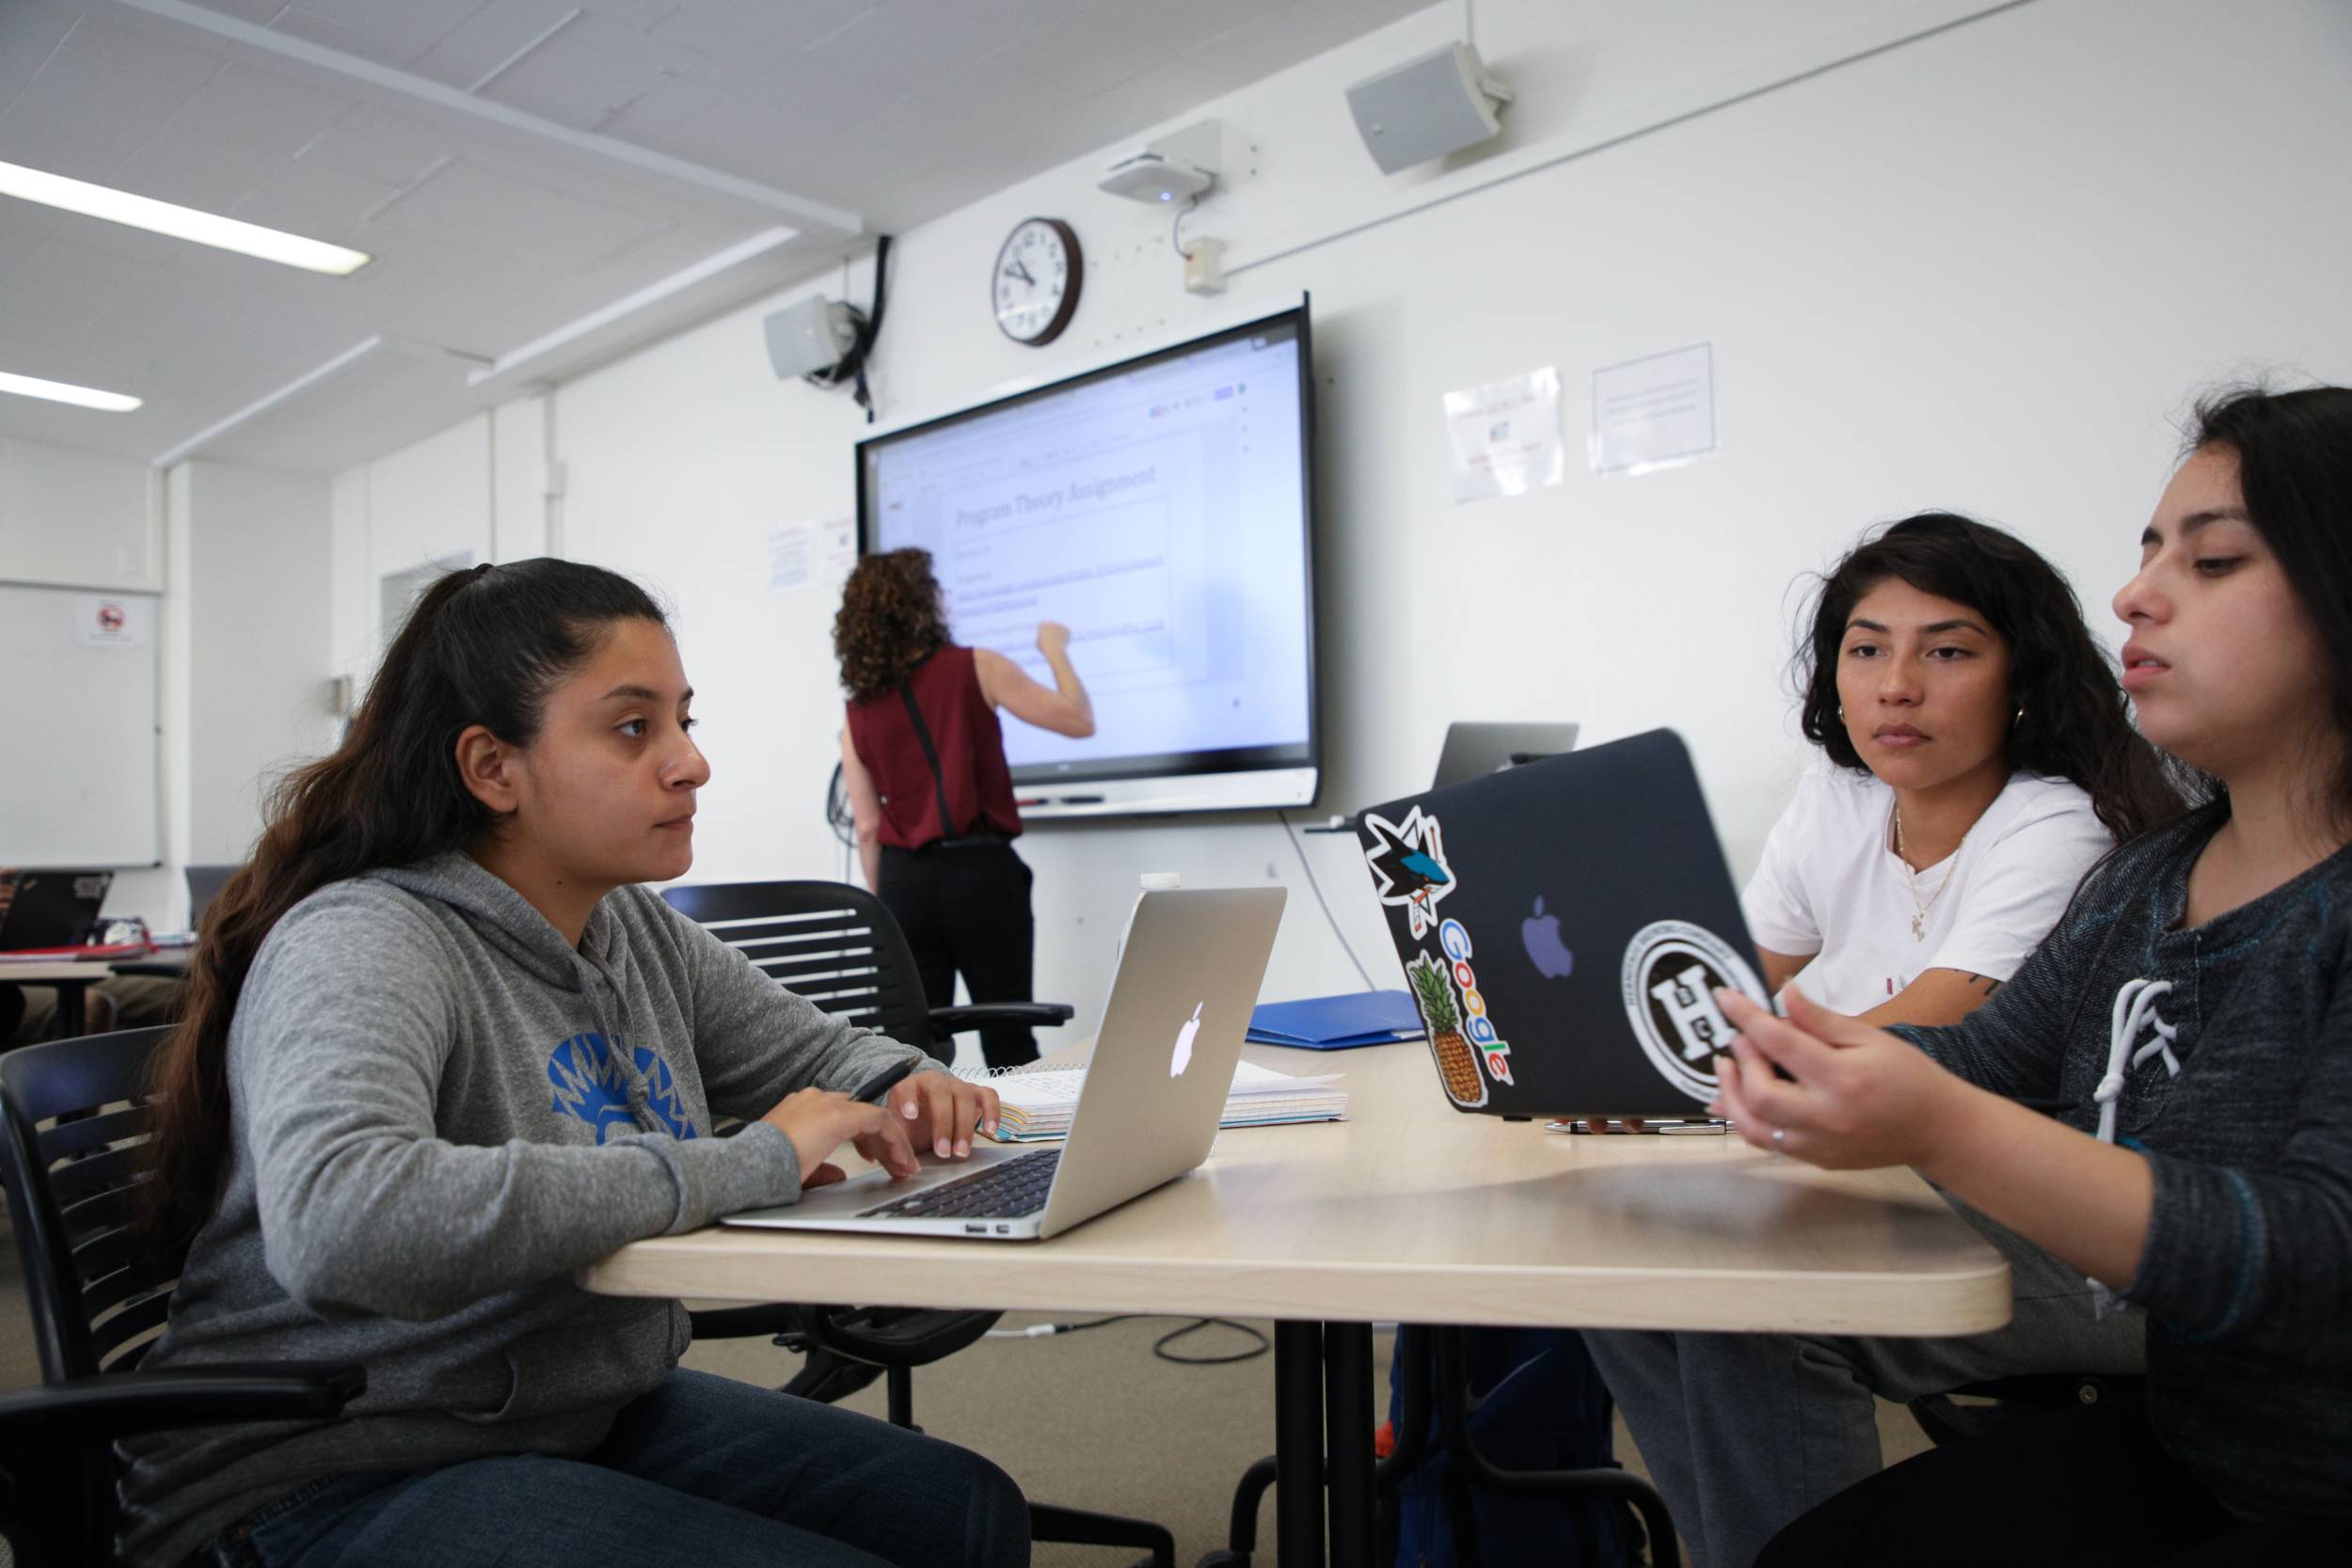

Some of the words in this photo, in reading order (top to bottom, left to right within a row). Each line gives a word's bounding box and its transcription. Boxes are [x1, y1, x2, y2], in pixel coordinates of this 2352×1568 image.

[956, 501, 1013, 529] Program
[1014, 488, 1064, 516] Theory
[1068, 465, 1157, 503] Assignment
[1441, 920, 1506, 1076] Google
[1650, 962, 1737, 1061] H
